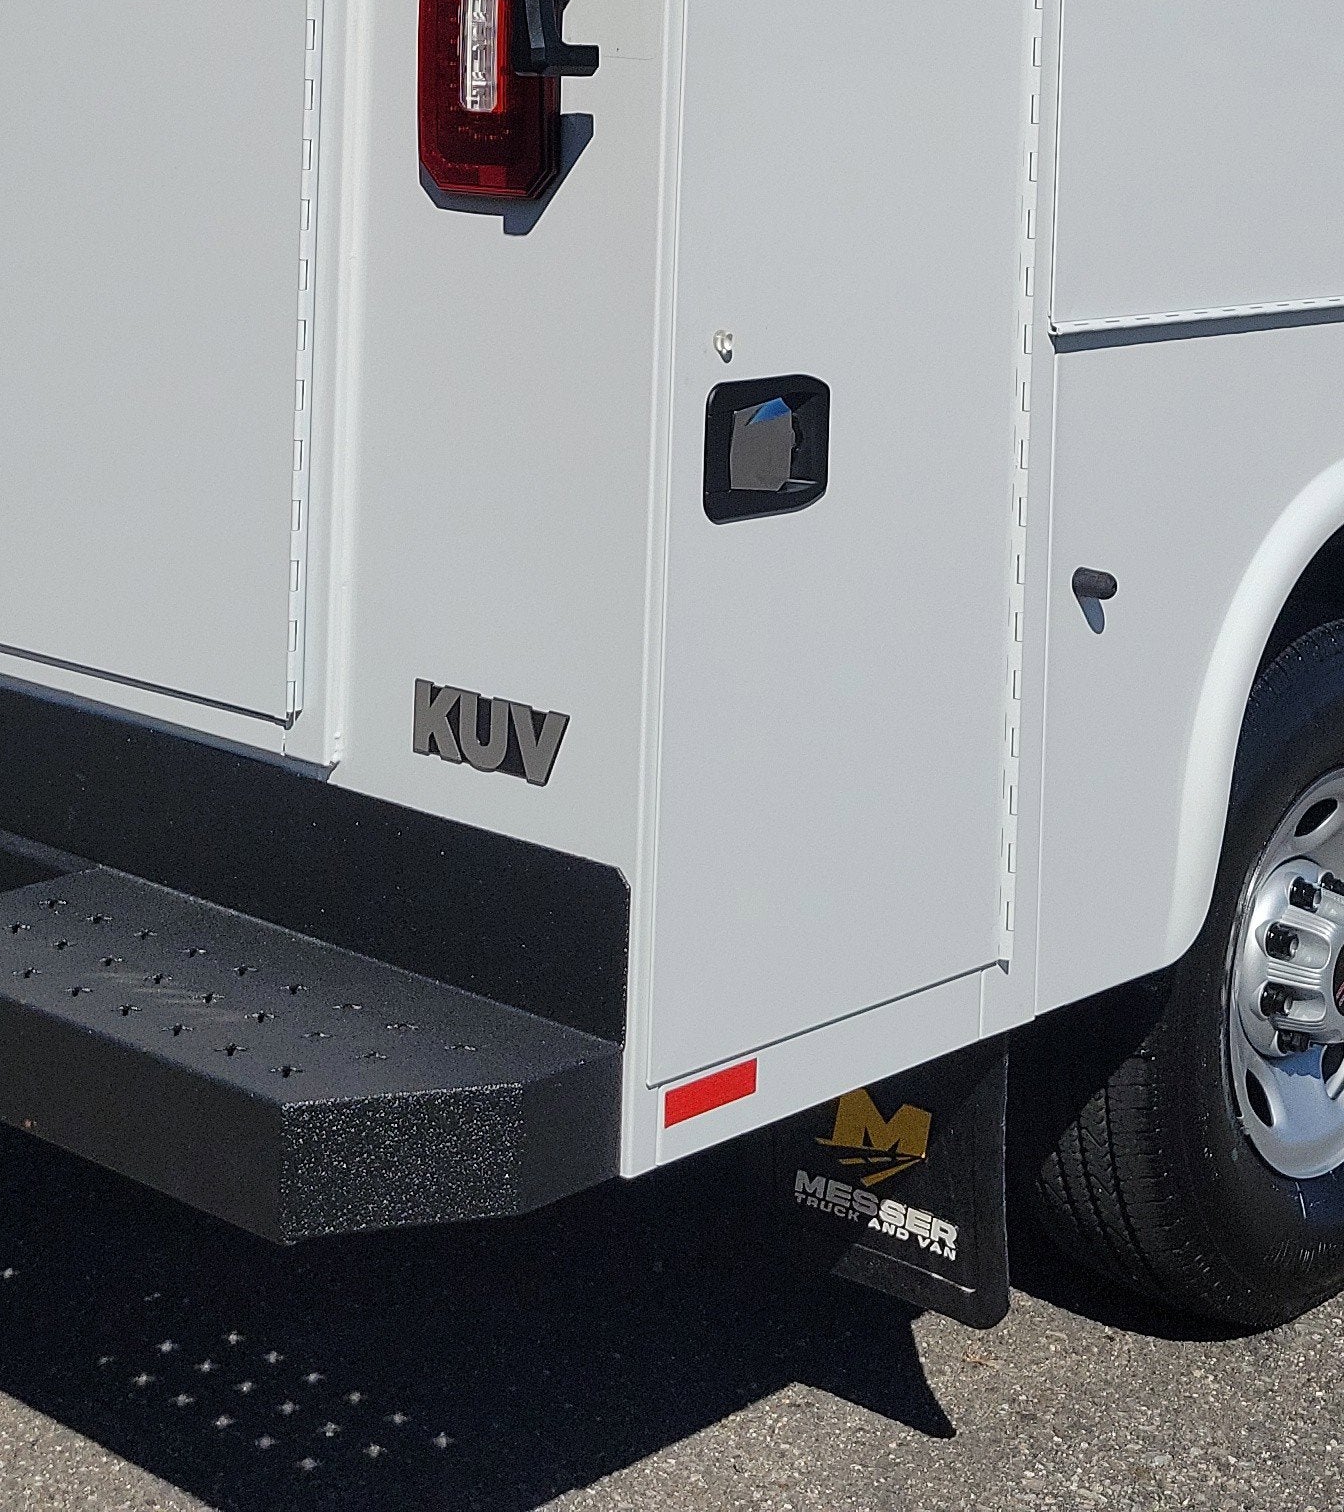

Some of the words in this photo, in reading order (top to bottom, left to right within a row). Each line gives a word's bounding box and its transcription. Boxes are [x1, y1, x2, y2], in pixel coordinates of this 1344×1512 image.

[413, 678, 570, 786] KUV
[793, 1193, 859, 1222] TRUCK
[867, 1217, 910, 1241] AND
[918, 1238, 957, 1261] VAN
[794, 1170, 958, 1248] MESSER
